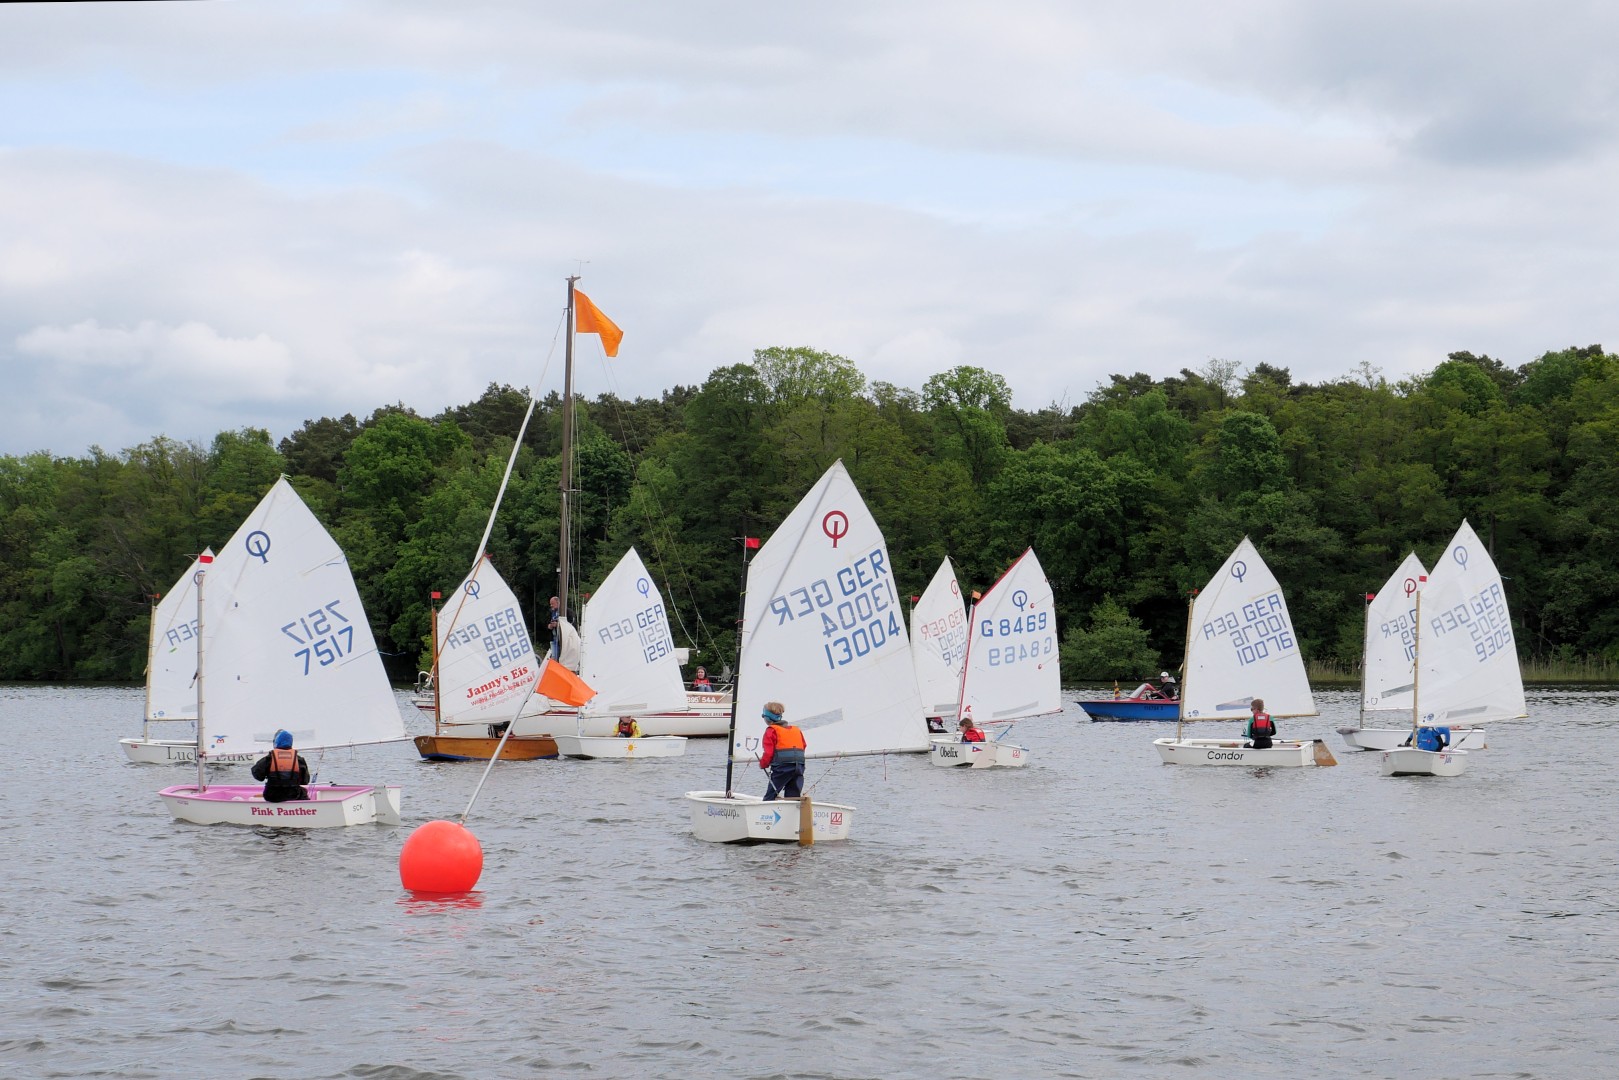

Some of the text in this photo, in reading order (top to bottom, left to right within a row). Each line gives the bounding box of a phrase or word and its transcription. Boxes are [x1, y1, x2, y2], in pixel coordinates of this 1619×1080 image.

[836, 548, 888, 597] GER
[484, 607, 517, 633] GER
[1242, 593, 1282, 622] GER
[824, 610, 900, 670] 13004
[981, 612, 1047, 637] G 8469
[294, 625, 353, 676] 7517
[488, 637, 531, 670] 8468
[643, 637, 673, 664] 12511
[1236, 631, 1294, 666] 10076
[1475, 624, 1511, 663] 9305
[466, 675, 509, 699] Janny's
[510, 666, 529, 680] Eis
[939, 746, 958, 758] Obelix
[1207, 750, 1244, 761] Condor
[250, 807, 317, 816] Pink Panther
